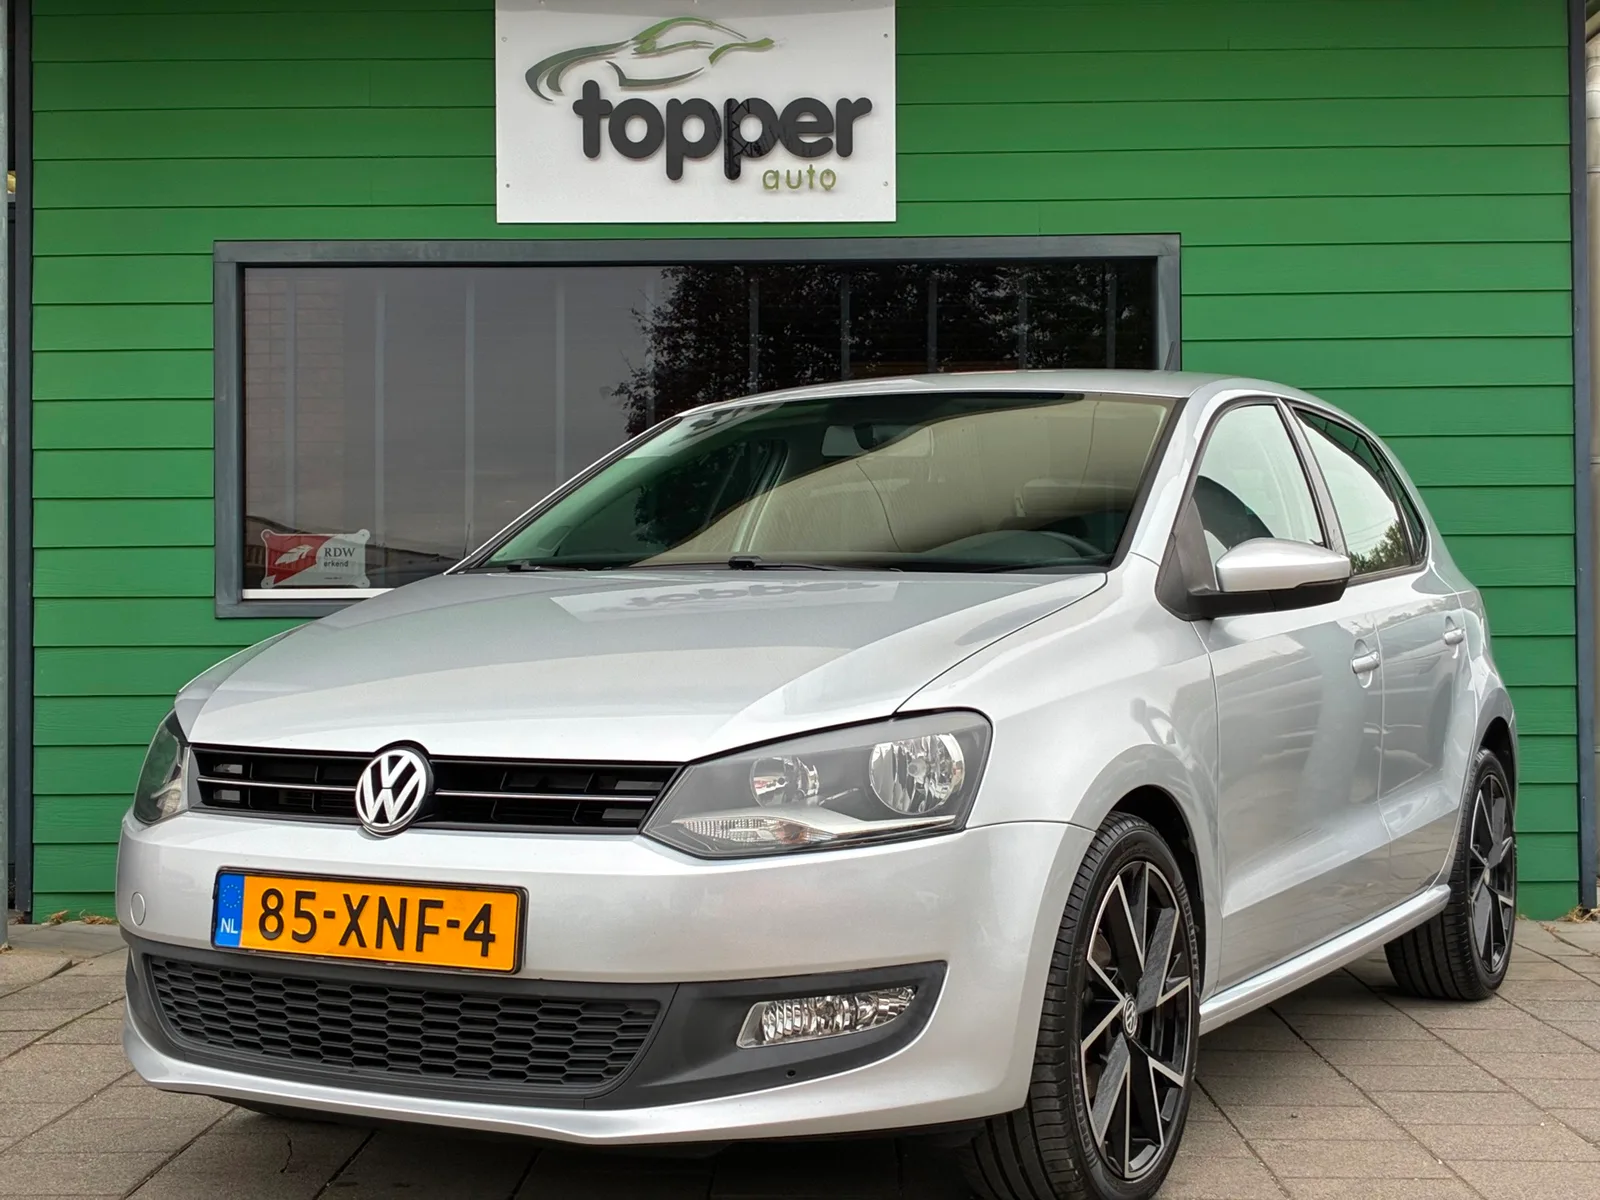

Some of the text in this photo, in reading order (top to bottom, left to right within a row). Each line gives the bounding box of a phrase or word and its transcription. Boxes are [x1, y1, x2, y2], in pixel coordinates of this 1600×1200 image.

[572, 79, 872, 181] topper
[762, 164, 837, 191] auto
[324, 548, 355, 557] RDW
[220, 917, 239, 934] NL
[258, 888, 496, 957] 85-XNF-4
